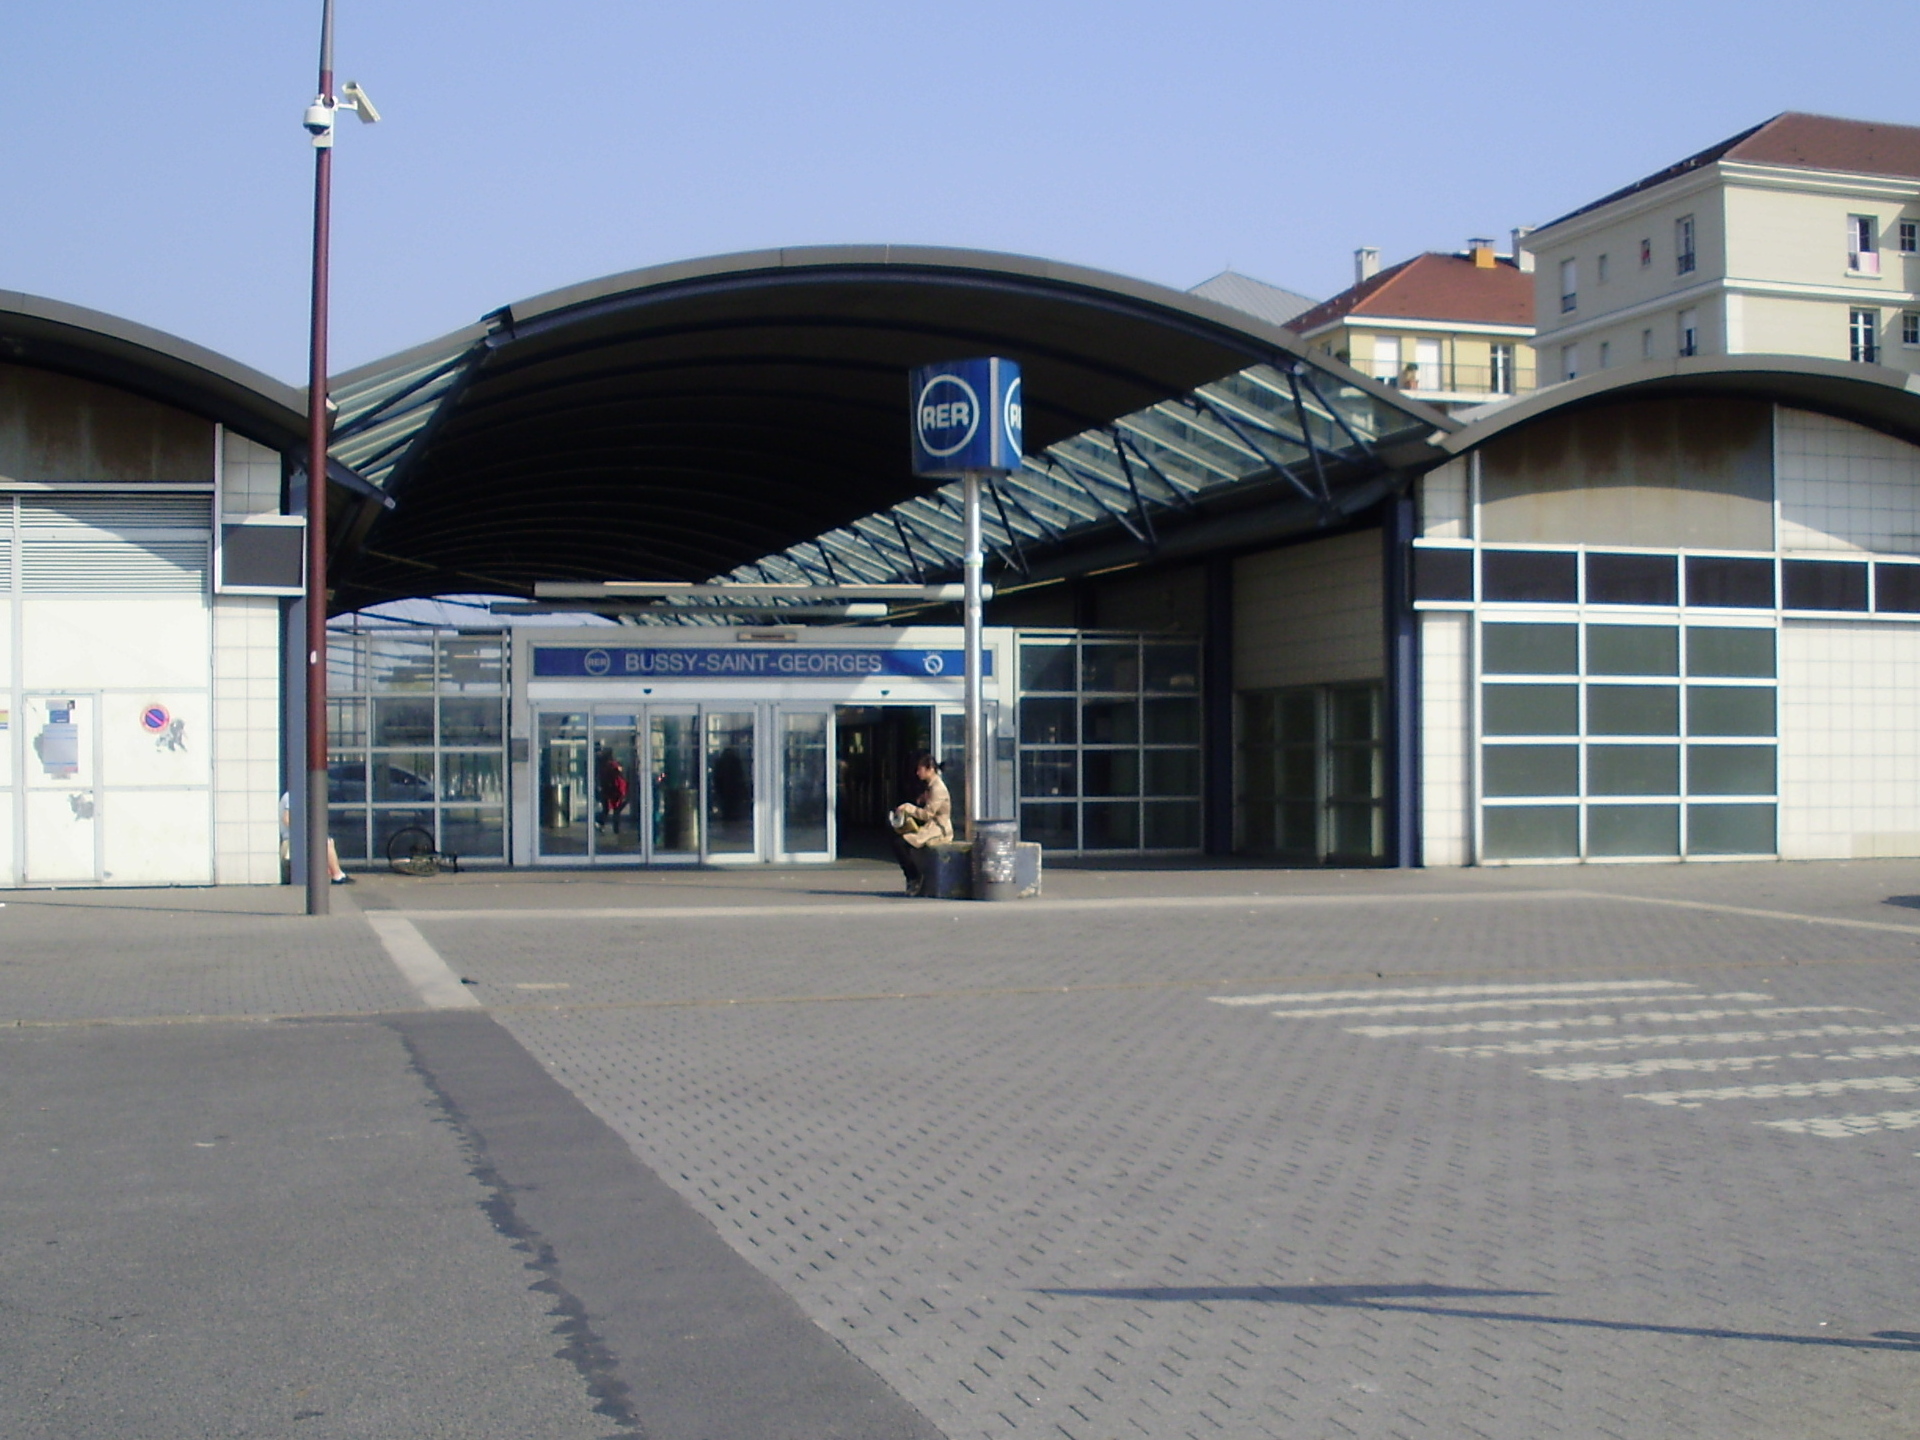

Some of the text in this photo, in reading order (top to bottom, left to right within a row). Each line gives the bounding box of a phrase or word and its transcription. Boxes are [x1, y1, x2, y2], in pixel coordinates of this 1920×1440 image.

[923, 402, 969, 430] RER
[587, 657, 608, 666] RER
[625, 653, 882, 672] BUSSY-SAINT-GEORGES
